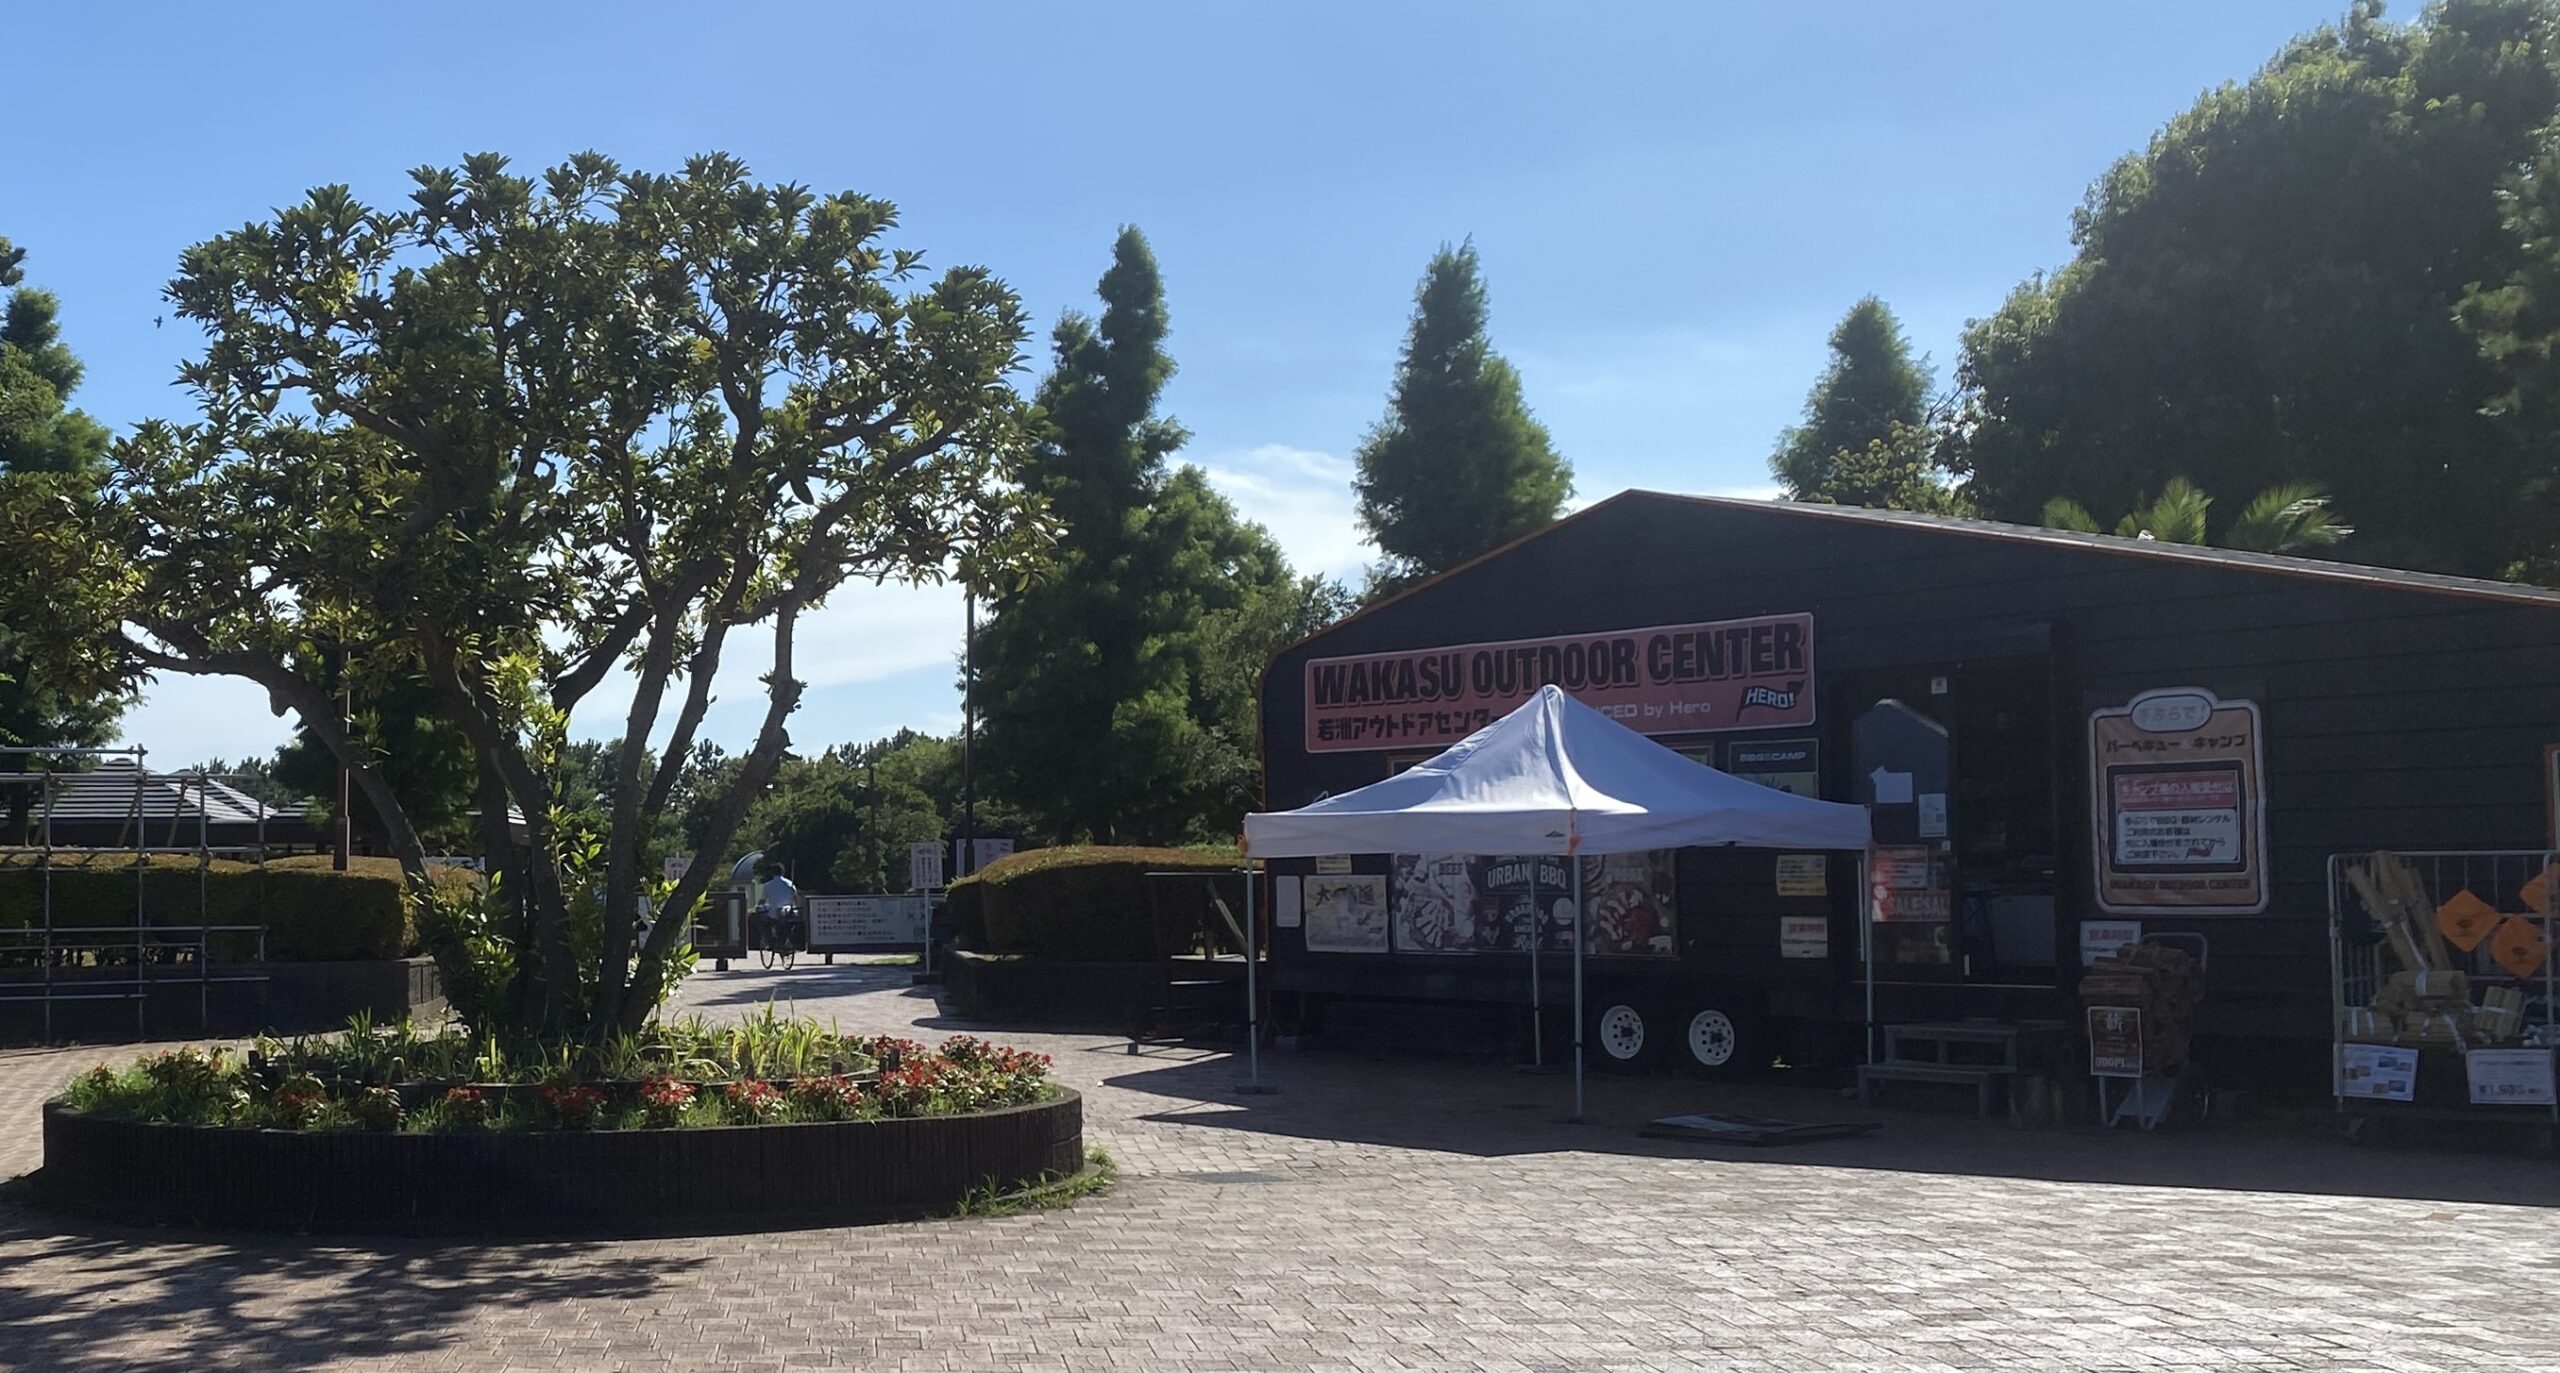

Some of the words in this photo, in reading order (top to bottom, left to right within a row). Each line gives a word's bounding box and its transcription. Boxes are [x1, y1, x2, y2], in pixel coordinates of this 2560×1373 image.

[1313, 653, 1464, 709] WAKASU
[1472, 637, 1640, 702] OUTDOOR
[1647, 622, 1808, 684] CENTER
[1745, 687, 1795, 710] HERO!
[1643, 703, 1664, 723] by
[1669, 701, 1712, 720] Hero
[1487, 863, 1533, 888] URBAN
[1539, 864, 1567, 890] BBQ
